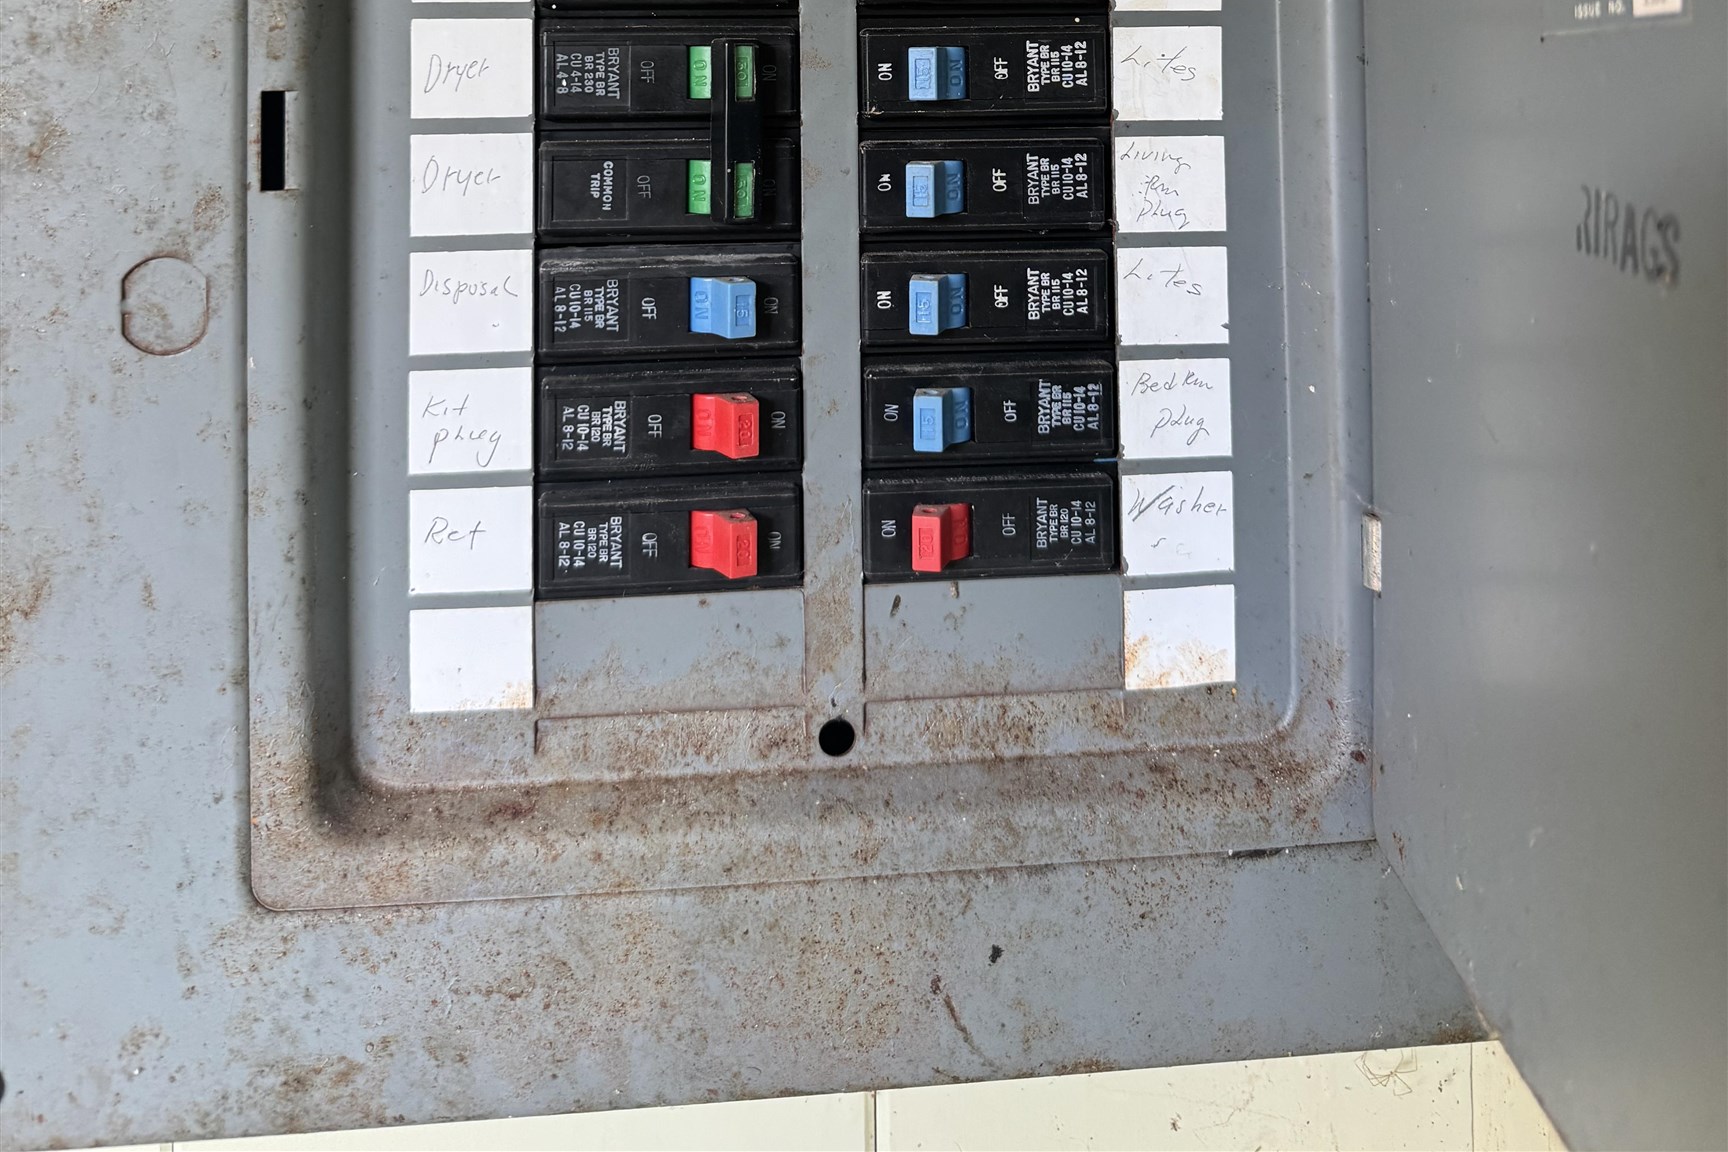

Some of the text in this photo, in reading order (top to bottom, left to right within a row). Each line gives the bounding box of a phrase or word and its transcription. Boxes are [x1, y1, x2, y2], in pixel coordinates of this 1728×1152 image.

[1574, 1, 1601, 19] ISSUE
[424, 54, 489, 94] Dryer
[556, 53, 568, 94] AL 4-8
[570, 53, 582, 93] CU 4-14
[584, 55, 594, 93] BR 230
[608, 48, 620, 99] BRYANT
[640, 60, 655, 83] OFF
[694, 60, 707, 86] ON
[878, 63, 892, 81] ON
[950, 59, 963, 87] ON
[994, 57, 1008, 80] OFF
[1026, 40, 1039, 92] BRYANT
[1050, 51, 1060, 82] BR 115
[1061, 44, 1073, 88] CU 10-14
[1075, 41, 1088, 86] AL 8-12
[422, 156, 501, 195] Dryer
[590, 173, 600, 199] TRIP
[602, 160, 614, 211] COMMON
[637, 175, 651, 199] OFF
[692, 174, 706, 202] ON
[878, 173, 891, 191] ON
[992, 169, 1007, 192] OFF
[1027, 153, 1039, 205] BRYANT
[1051, 164, 1060, 195] BR 115
[1062, 157, 1074, 200] CU 10-14
[1075, 153, 1088, 198] AL 8-12
[554, 287, 566, 333] AL 8-12
[569, 284, 581, 330] CU 10-14
[584, 290, 593, 322] BR 115
[607, 280, 619, 333] BRYANT
[642, 297, 656, 320] OFF
[694, 291, 710, 321] ON
[764, 297, 778, 314] ON
[876, 291, 891, 309] ON
[951, 286, 964, 315] ON
[994, 284, 1008, 308] OFF
[1027, 268, 1040, 320] BRYANT
[1041, 272, 1051, 313] TYPE BR
[1051, 278, 1060, 310] BR 115
[1062, 272, 1074, 316] CU 10-14
[1076, 269, 1089, 314] AL 8-12
[422, 394, 470, 418] Kit
[771, 411, 786, 429] ON
[884, 404, 899, 422] ON
[1003, 400, 1017, 422] OFF
[1038, 379, 1051, 434] BRYANT
[1052, 385, 1062, 428] TYPE BR
[1062, 392, 1072, 425] BR 115
[1073, 386, 1086, 431] CU 10-14
[1087, 383, 1100, 430] AL 8-12
[562, 407, 574, 450] AL 8-12
[577, 404, 590, 451] CU 10-14
[591, 411, 601, 442] BR 120
[602, 406, 612, 446] TYPE BR
[613, 400, 627, 453] BRYANT
[648, 415, 662, 438] OFF
[1036, 497, 1048, 548] BRYANT
[1071, 500, 1082, 545] CU 10-14
[1085, 501, 1096, 544] AL 8-12
[1128, 484, 1227, 523] Washer
[599, 522, 608, 562] TYPE BR
[768, 532, 781, 549] ON
[881, 520, 896, 538] ON
[1002, 513, 1016, 536] OFF
[1049, 504, 1058, 542] TYPE BR
[1060, 508, 1069, 538] BR 120
[559, 522, 570, 568] AL 8-12
[574, 521, 585, 568] CU 10-14
[588, 528, 596, 558] BR 120
[610, 516, 622, 569] BRYANT
[642, 532, 657, 558] OFF
